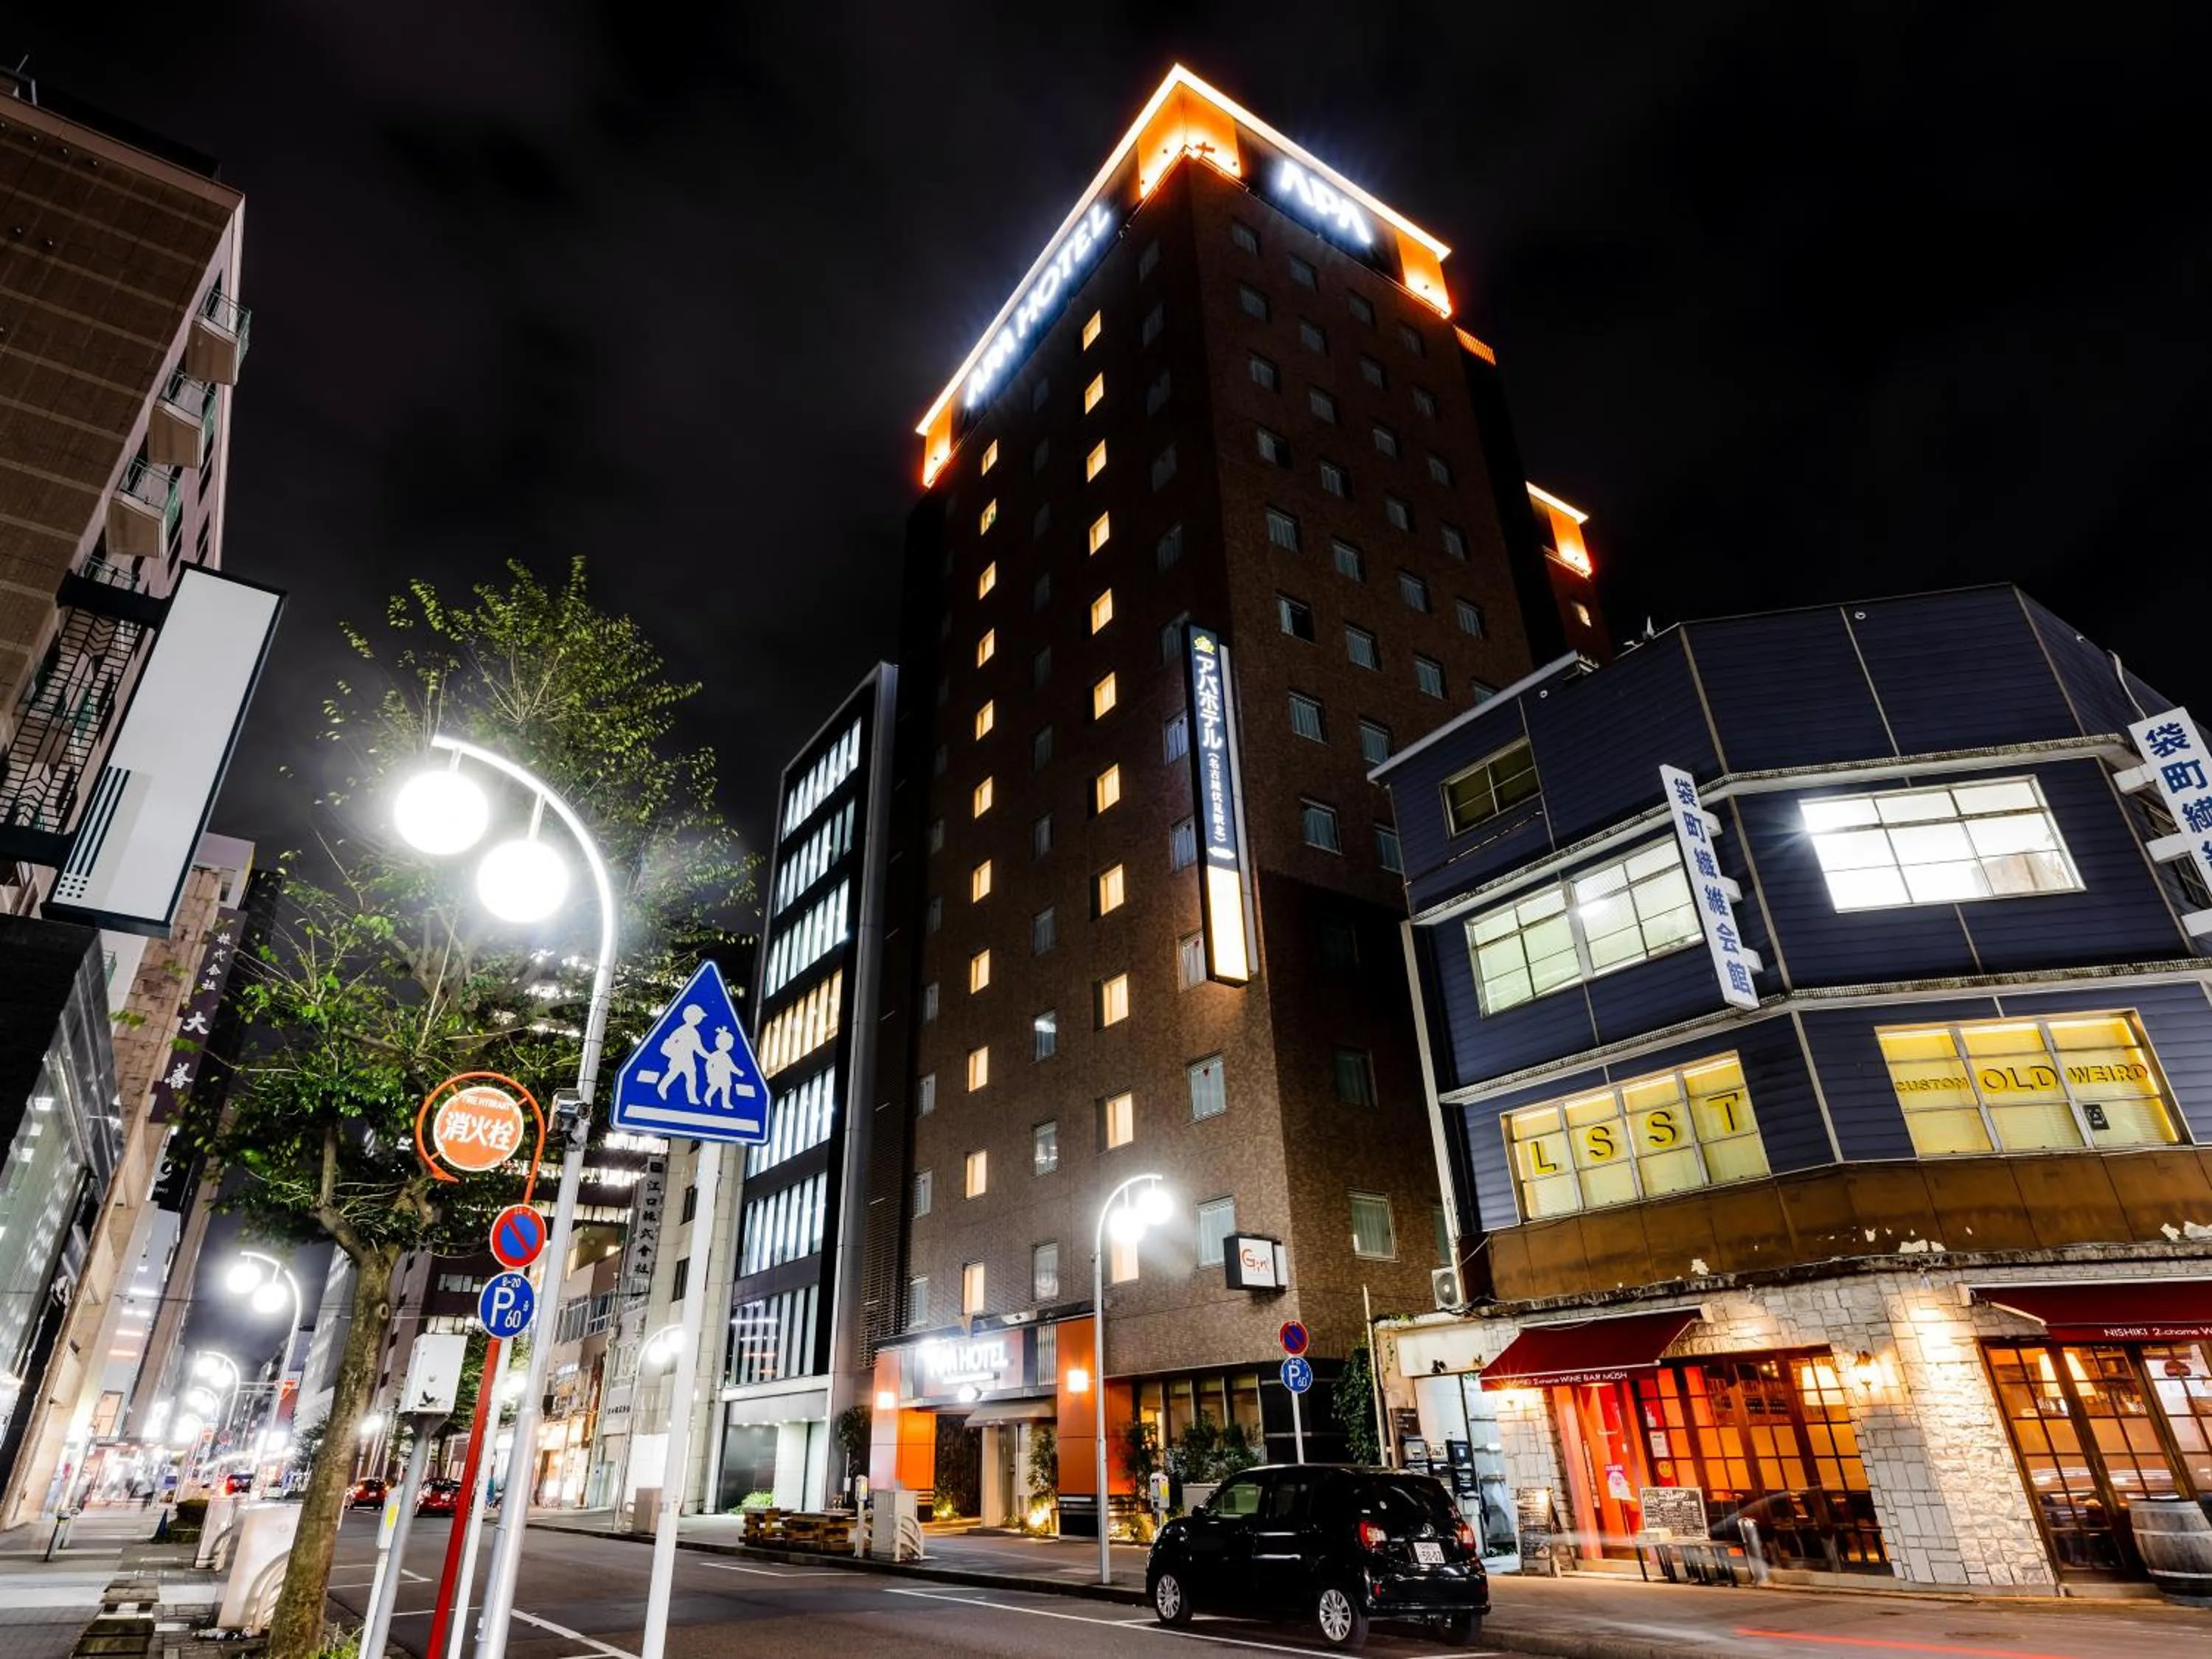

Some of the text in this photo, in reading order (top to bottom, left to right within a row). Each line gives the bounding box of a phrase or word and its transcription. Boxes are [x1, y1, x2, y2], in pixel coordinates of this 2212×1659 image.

[1279, 160, 1372, 245] APA
[1015, 204, 1111, 338] HOTEL
[1195, 655, 1223, 750] アパホテル
[1895, 1063, 2149, 1093] CUSTOM OLD WEIRD
[441, 1110, 515, 1152] 消火栓
[502, 1276, 521, 1288] 8-20
[490, 1287, 515, 1327] P
[504, 1309, 522, 1328] 60
[2104, 1328, 2149, 1337] NISHIKI
[959, 1340, 1009, 1373] HOTEL
[1288, 1365, 1301, 1387] P
[1559, 1374, 1582, 1383] WINE
[1583, 1373, 1601, 1381] BAR
